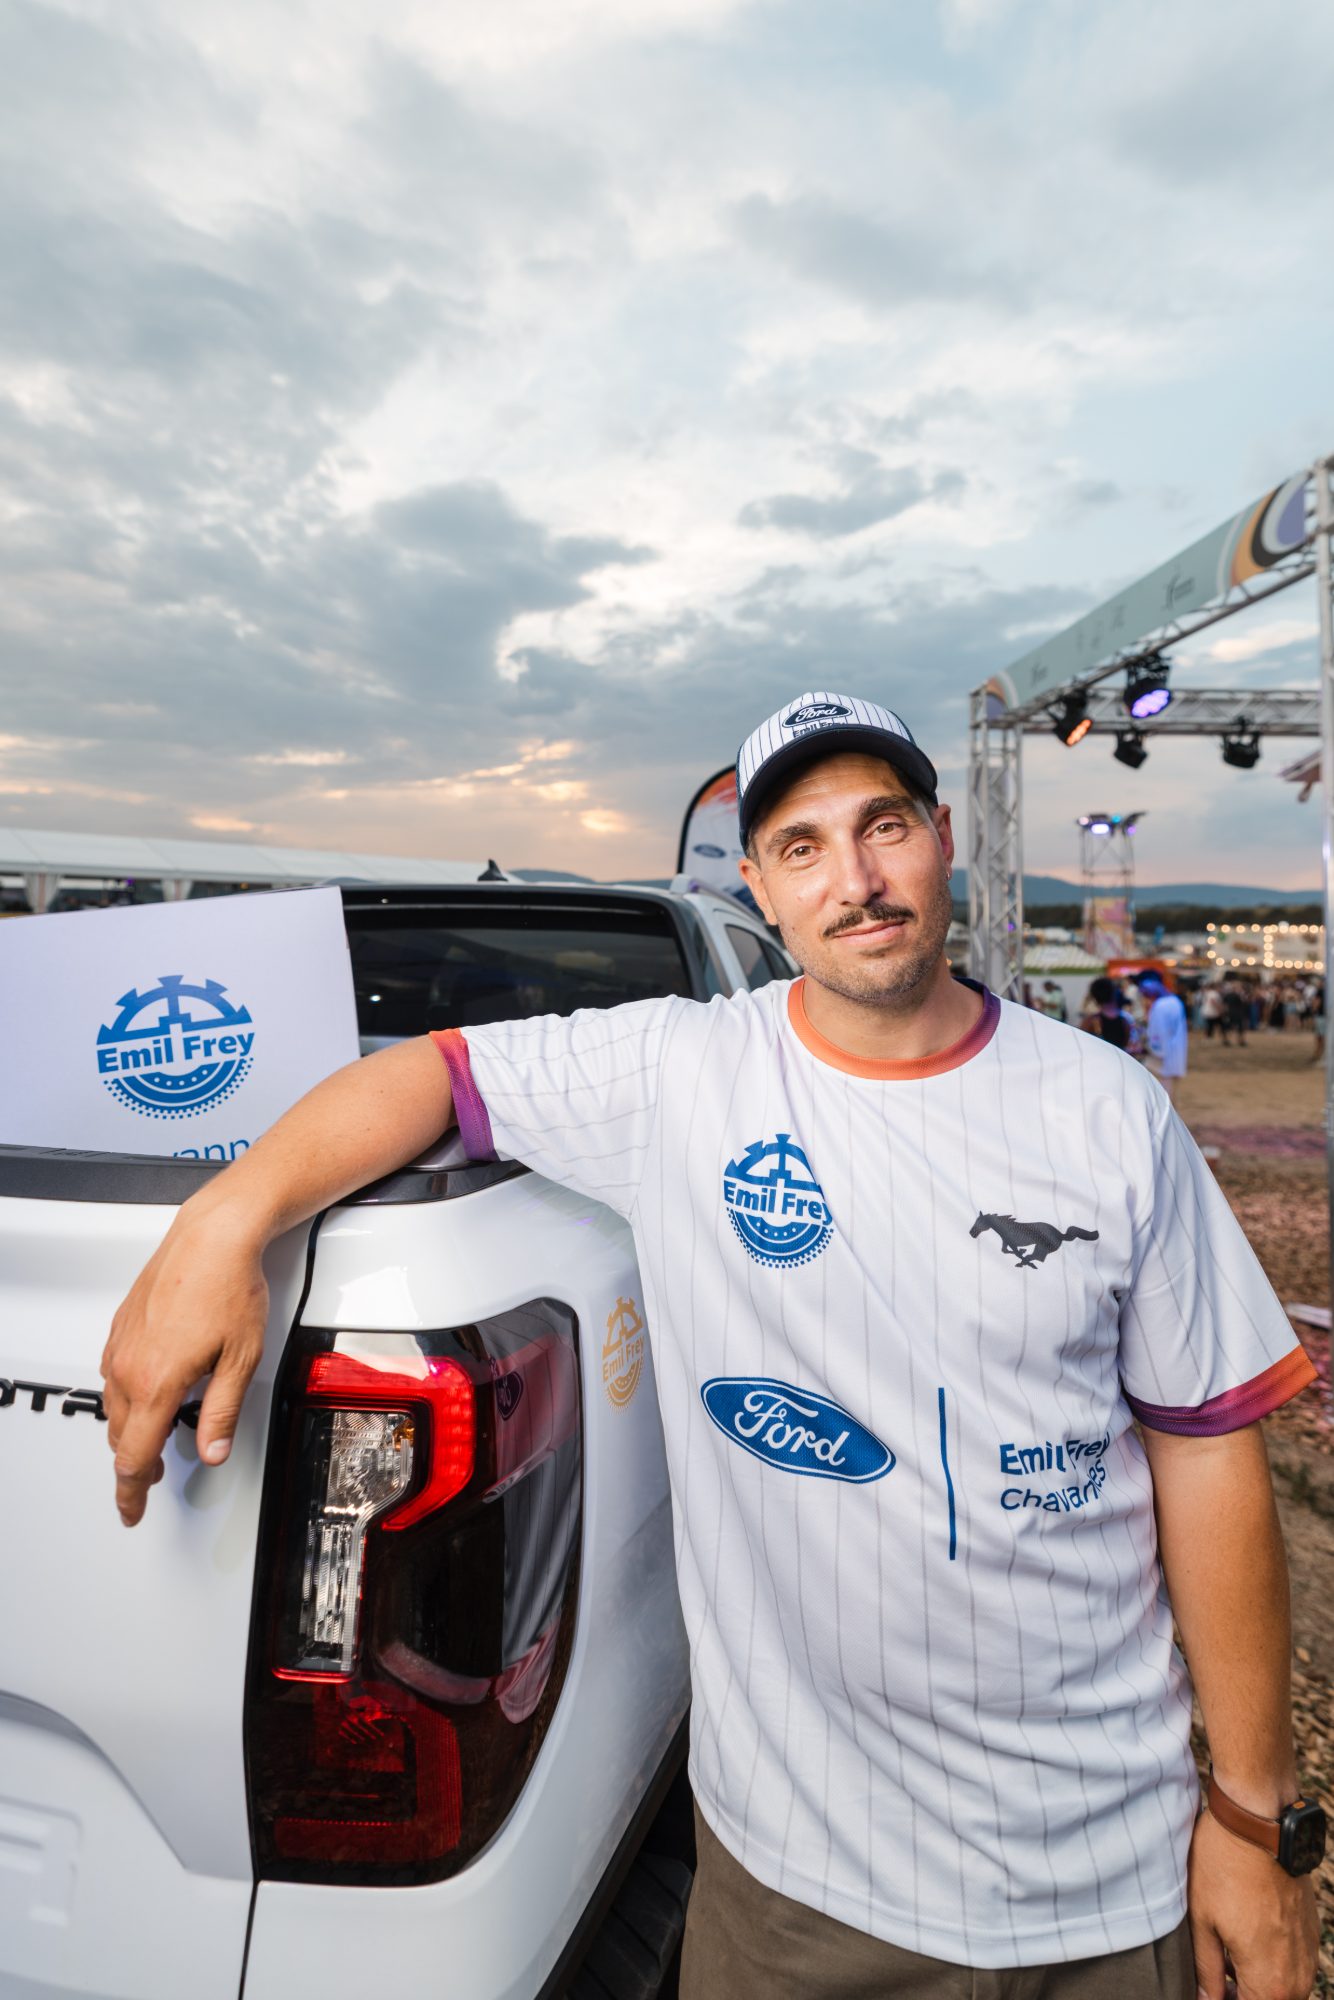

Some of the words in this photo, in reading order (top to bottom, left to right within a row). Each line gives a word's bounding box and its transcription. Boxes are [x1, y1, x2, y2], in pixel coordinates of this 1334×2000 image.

[795, 704, 837, 722] Ford
[97, 1038, 174, 1074] Emil
[183, 1032, 255, 1061] Frey
[723, 1180, 777, 1213] Emil
[781, 1192, 833, 1226] Frey
[602, 1347, 625, 1383] Emil
[625, 1336, 645, 1362] Frey
[734, 1390, 850, 1466] Ford
[999, 1441, 1067, 1476] Emil
[1065, 1431, 1111, 1470] Frey
[1000, 1458, 1106, 1513] Chavanes
